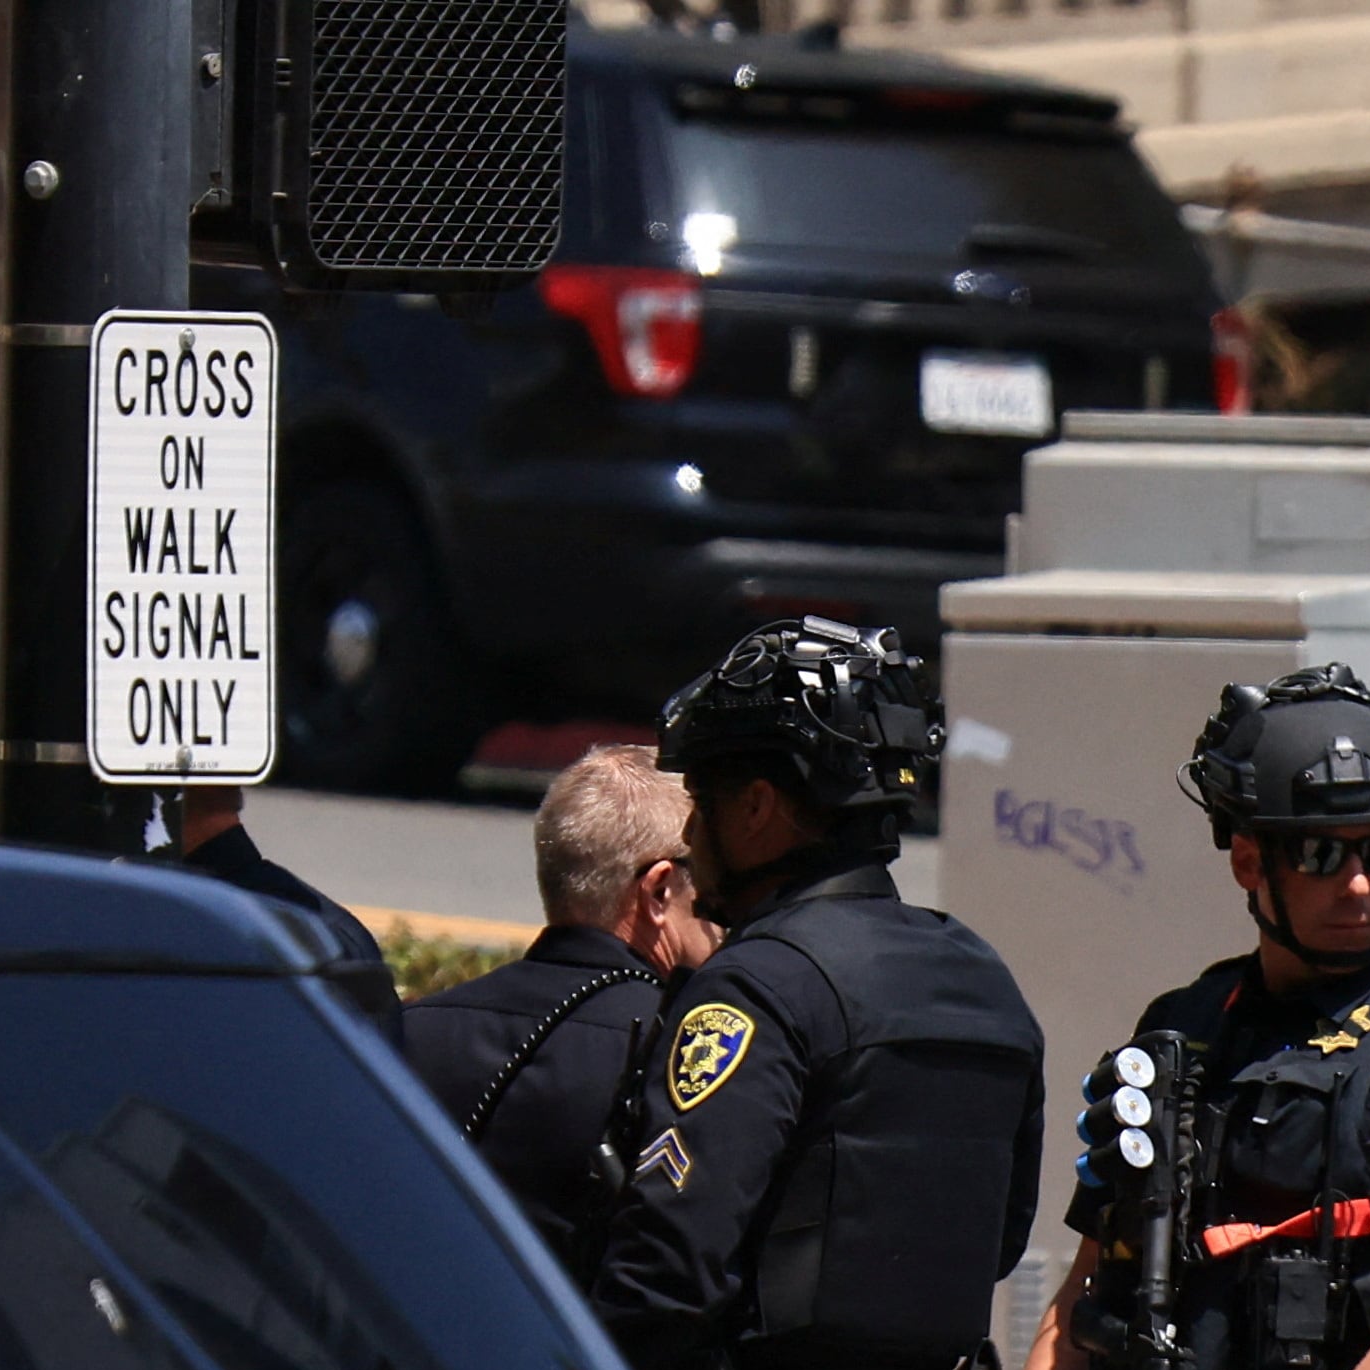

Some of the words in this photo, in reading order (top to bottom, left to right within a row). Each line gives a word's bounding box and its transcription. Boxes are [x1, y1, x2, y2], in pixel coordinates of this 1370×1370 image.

[115, 348, 254, 418] CROSS
[160, 435, 205, 490] ON
[124, 508, 237, 575] WALK
[103, 591, 260, 660] SIGNAL
[130, 678, 236, 746] ONLY
